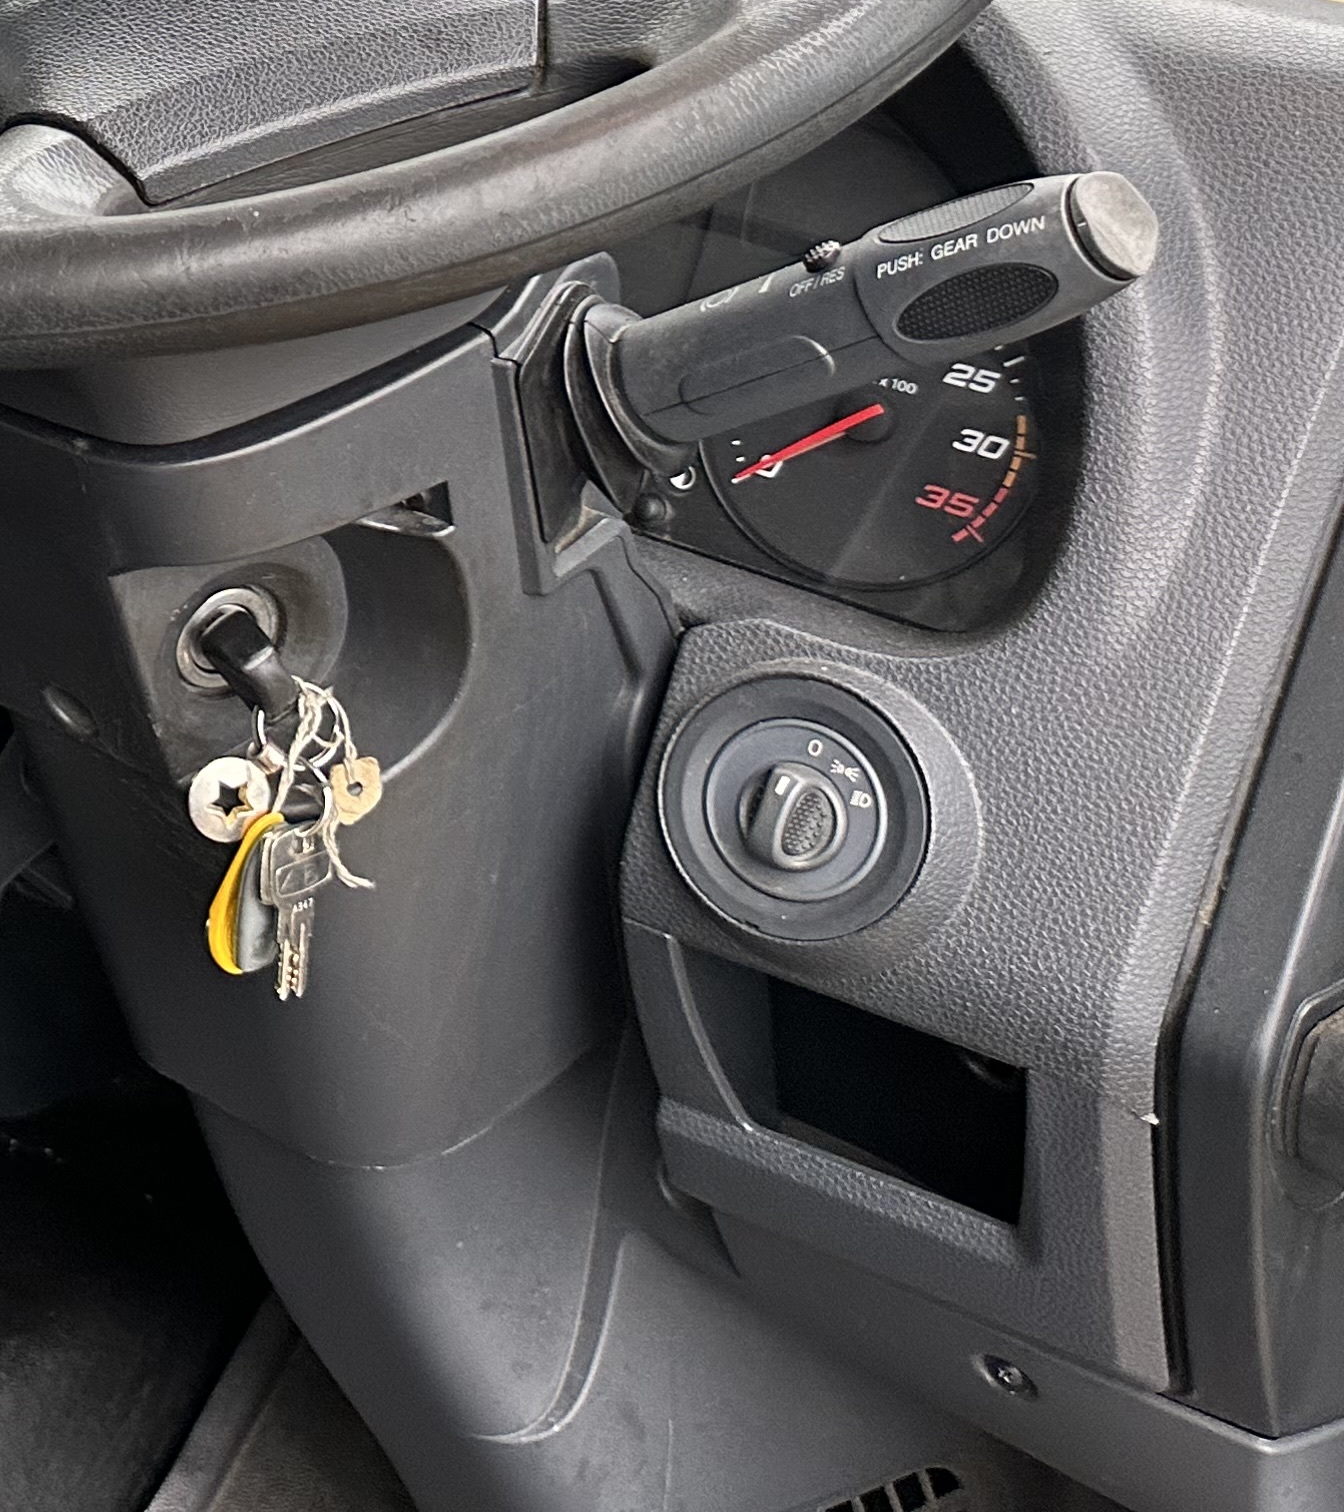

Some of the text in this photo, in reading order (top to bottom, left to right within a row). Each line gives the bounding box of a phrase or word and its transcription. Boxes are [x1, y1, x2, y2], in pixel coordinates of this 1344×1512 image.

[876, 215, 1046, 279] PUSH: GEAR DOWN
[942, 363, 1002, 394] 25
[952, 428, 1011, 460] 30
[915, 484, 981, 518] 35
